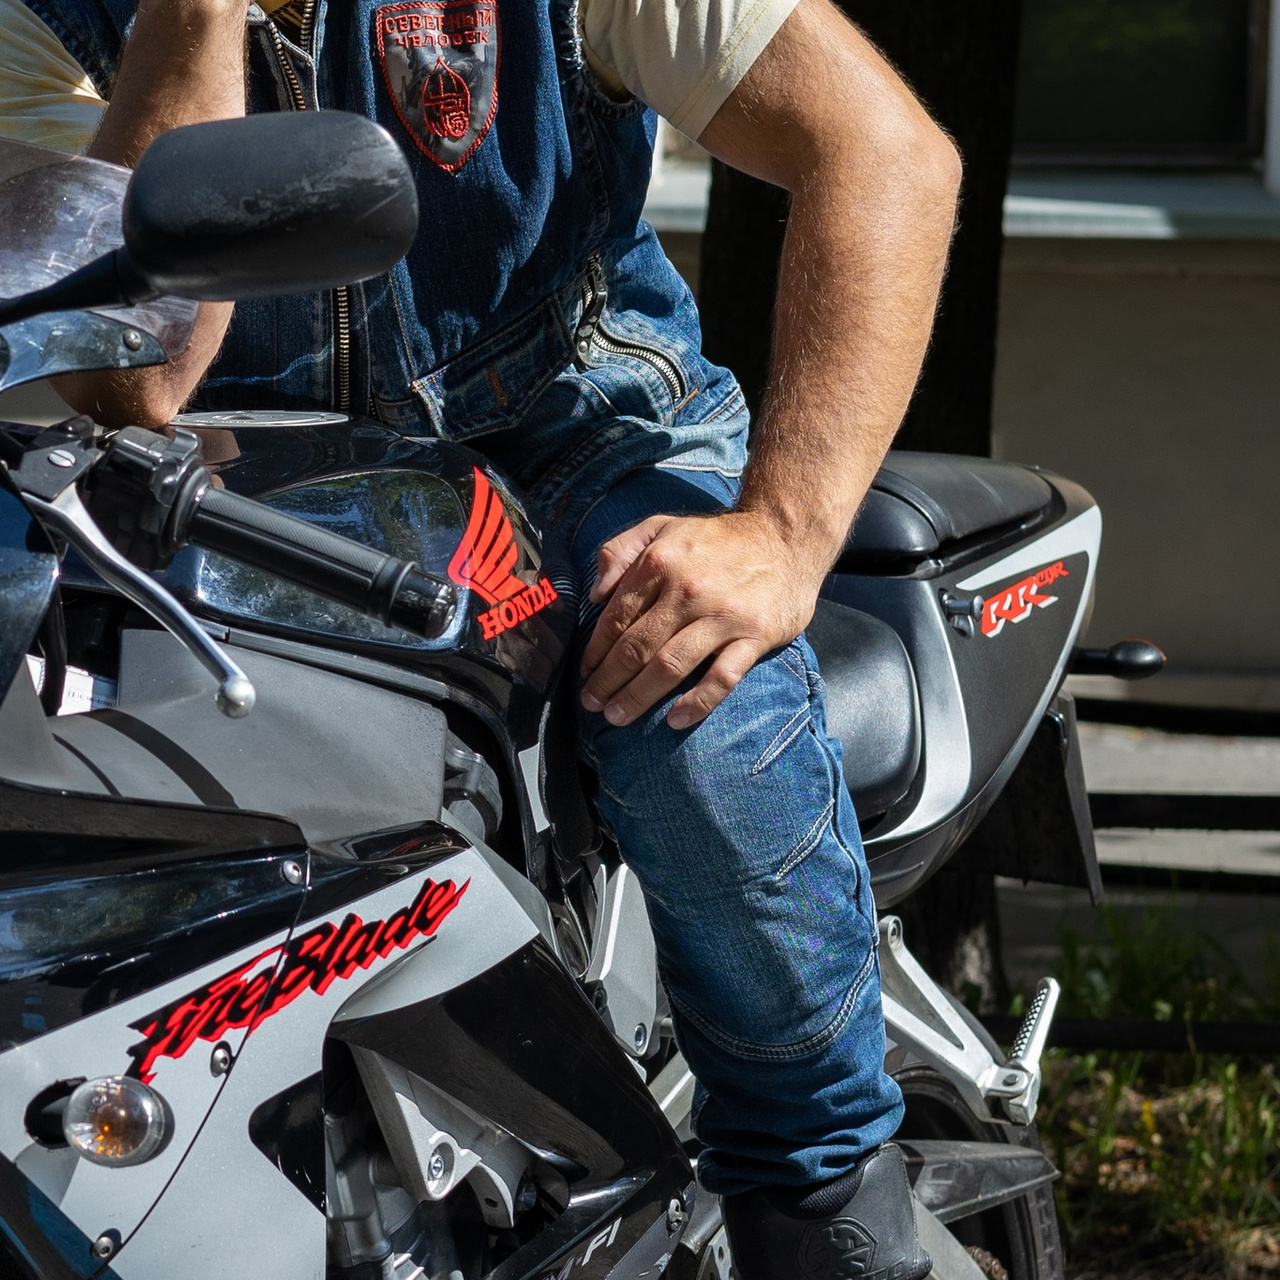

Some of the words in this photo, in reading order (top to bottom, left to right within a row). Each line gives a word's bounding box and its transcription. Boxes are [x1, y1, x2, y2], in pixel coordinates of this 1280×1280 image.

[384, 6, 494, 35] СЕВЕРНЫЙ
[395, 30, 490, 49] ЧЕЛОВЕК
[1034, 560, 1069, 587] CBR
[477, 577, 558, 640] HONDA
[981, 576, 1058, 638] RR
